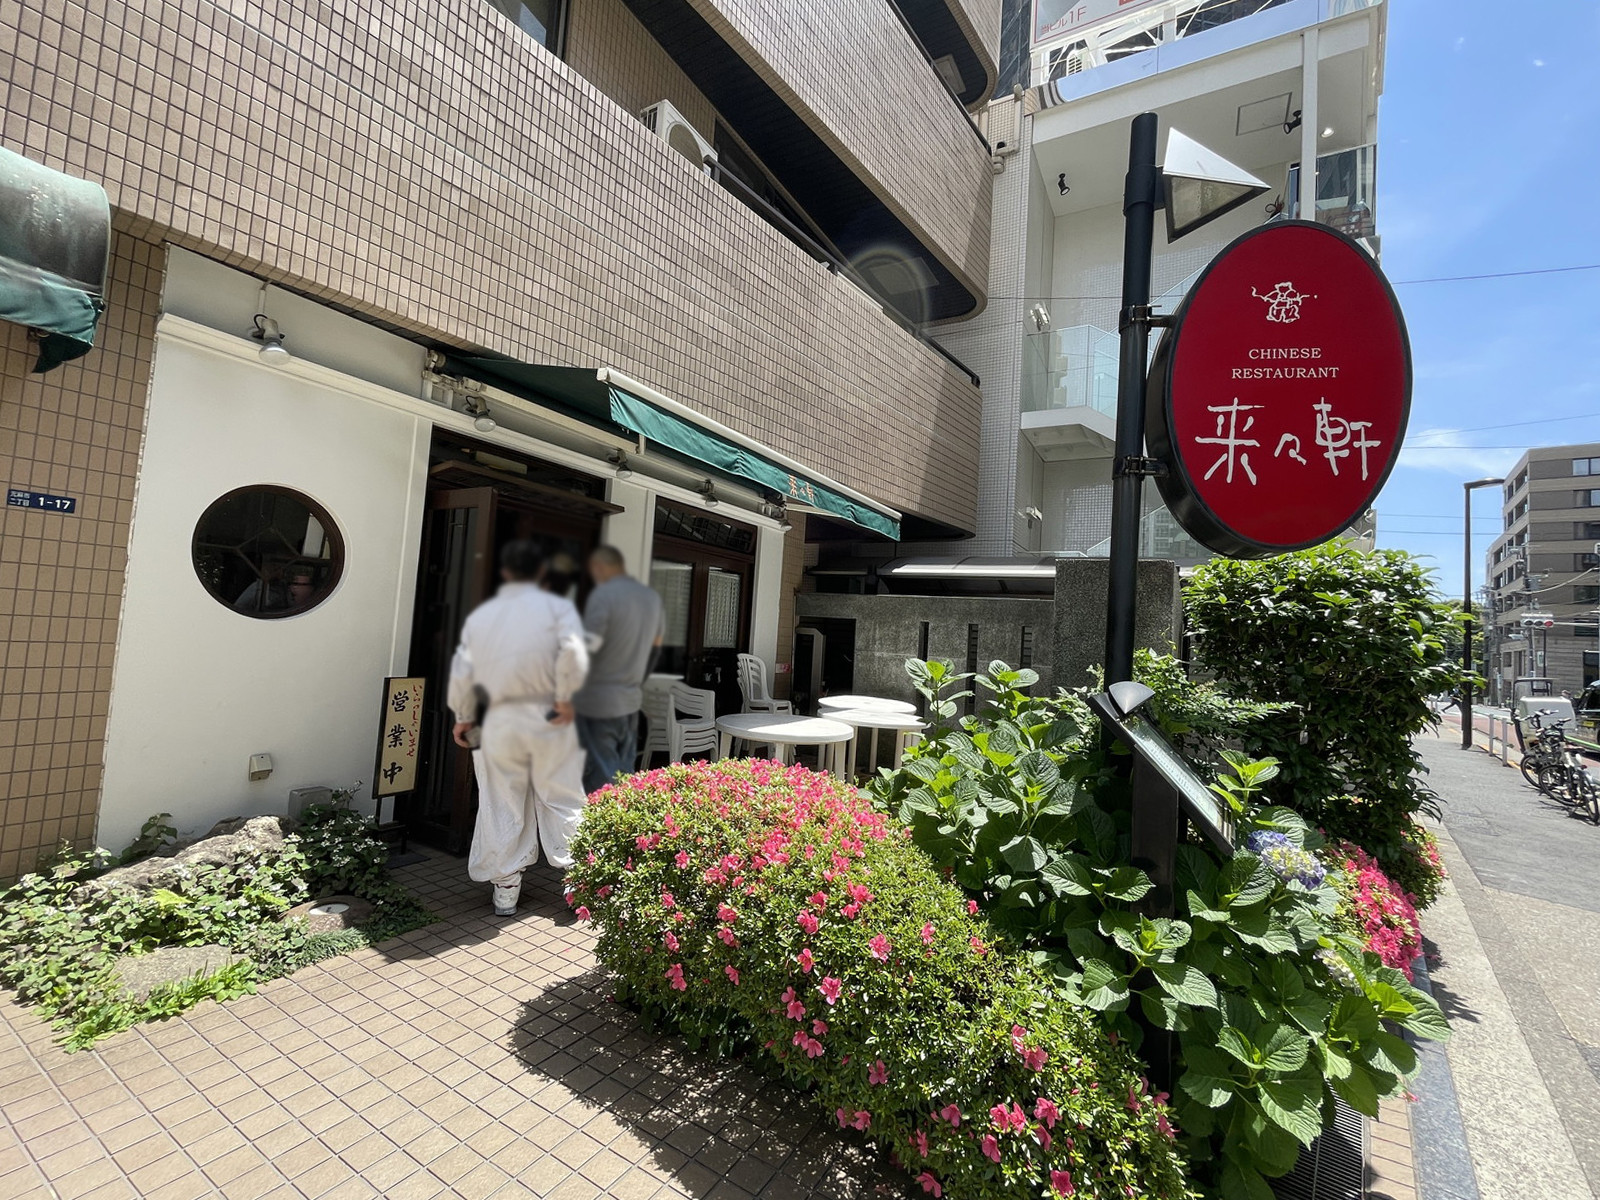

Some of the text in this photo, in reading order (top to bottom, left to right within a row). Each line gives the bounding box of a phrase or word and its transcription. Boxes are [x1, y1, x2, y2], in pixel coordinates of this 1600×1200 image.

[1248, 347, 1322, 360] CHINESE
[1231, 367, 1340, 379] RESTAURANT
[1195, 397, 1381, 485] 来々軒
[38, 496, 71, 510] 1-17
[383, 690, 409, 785] 営業中
